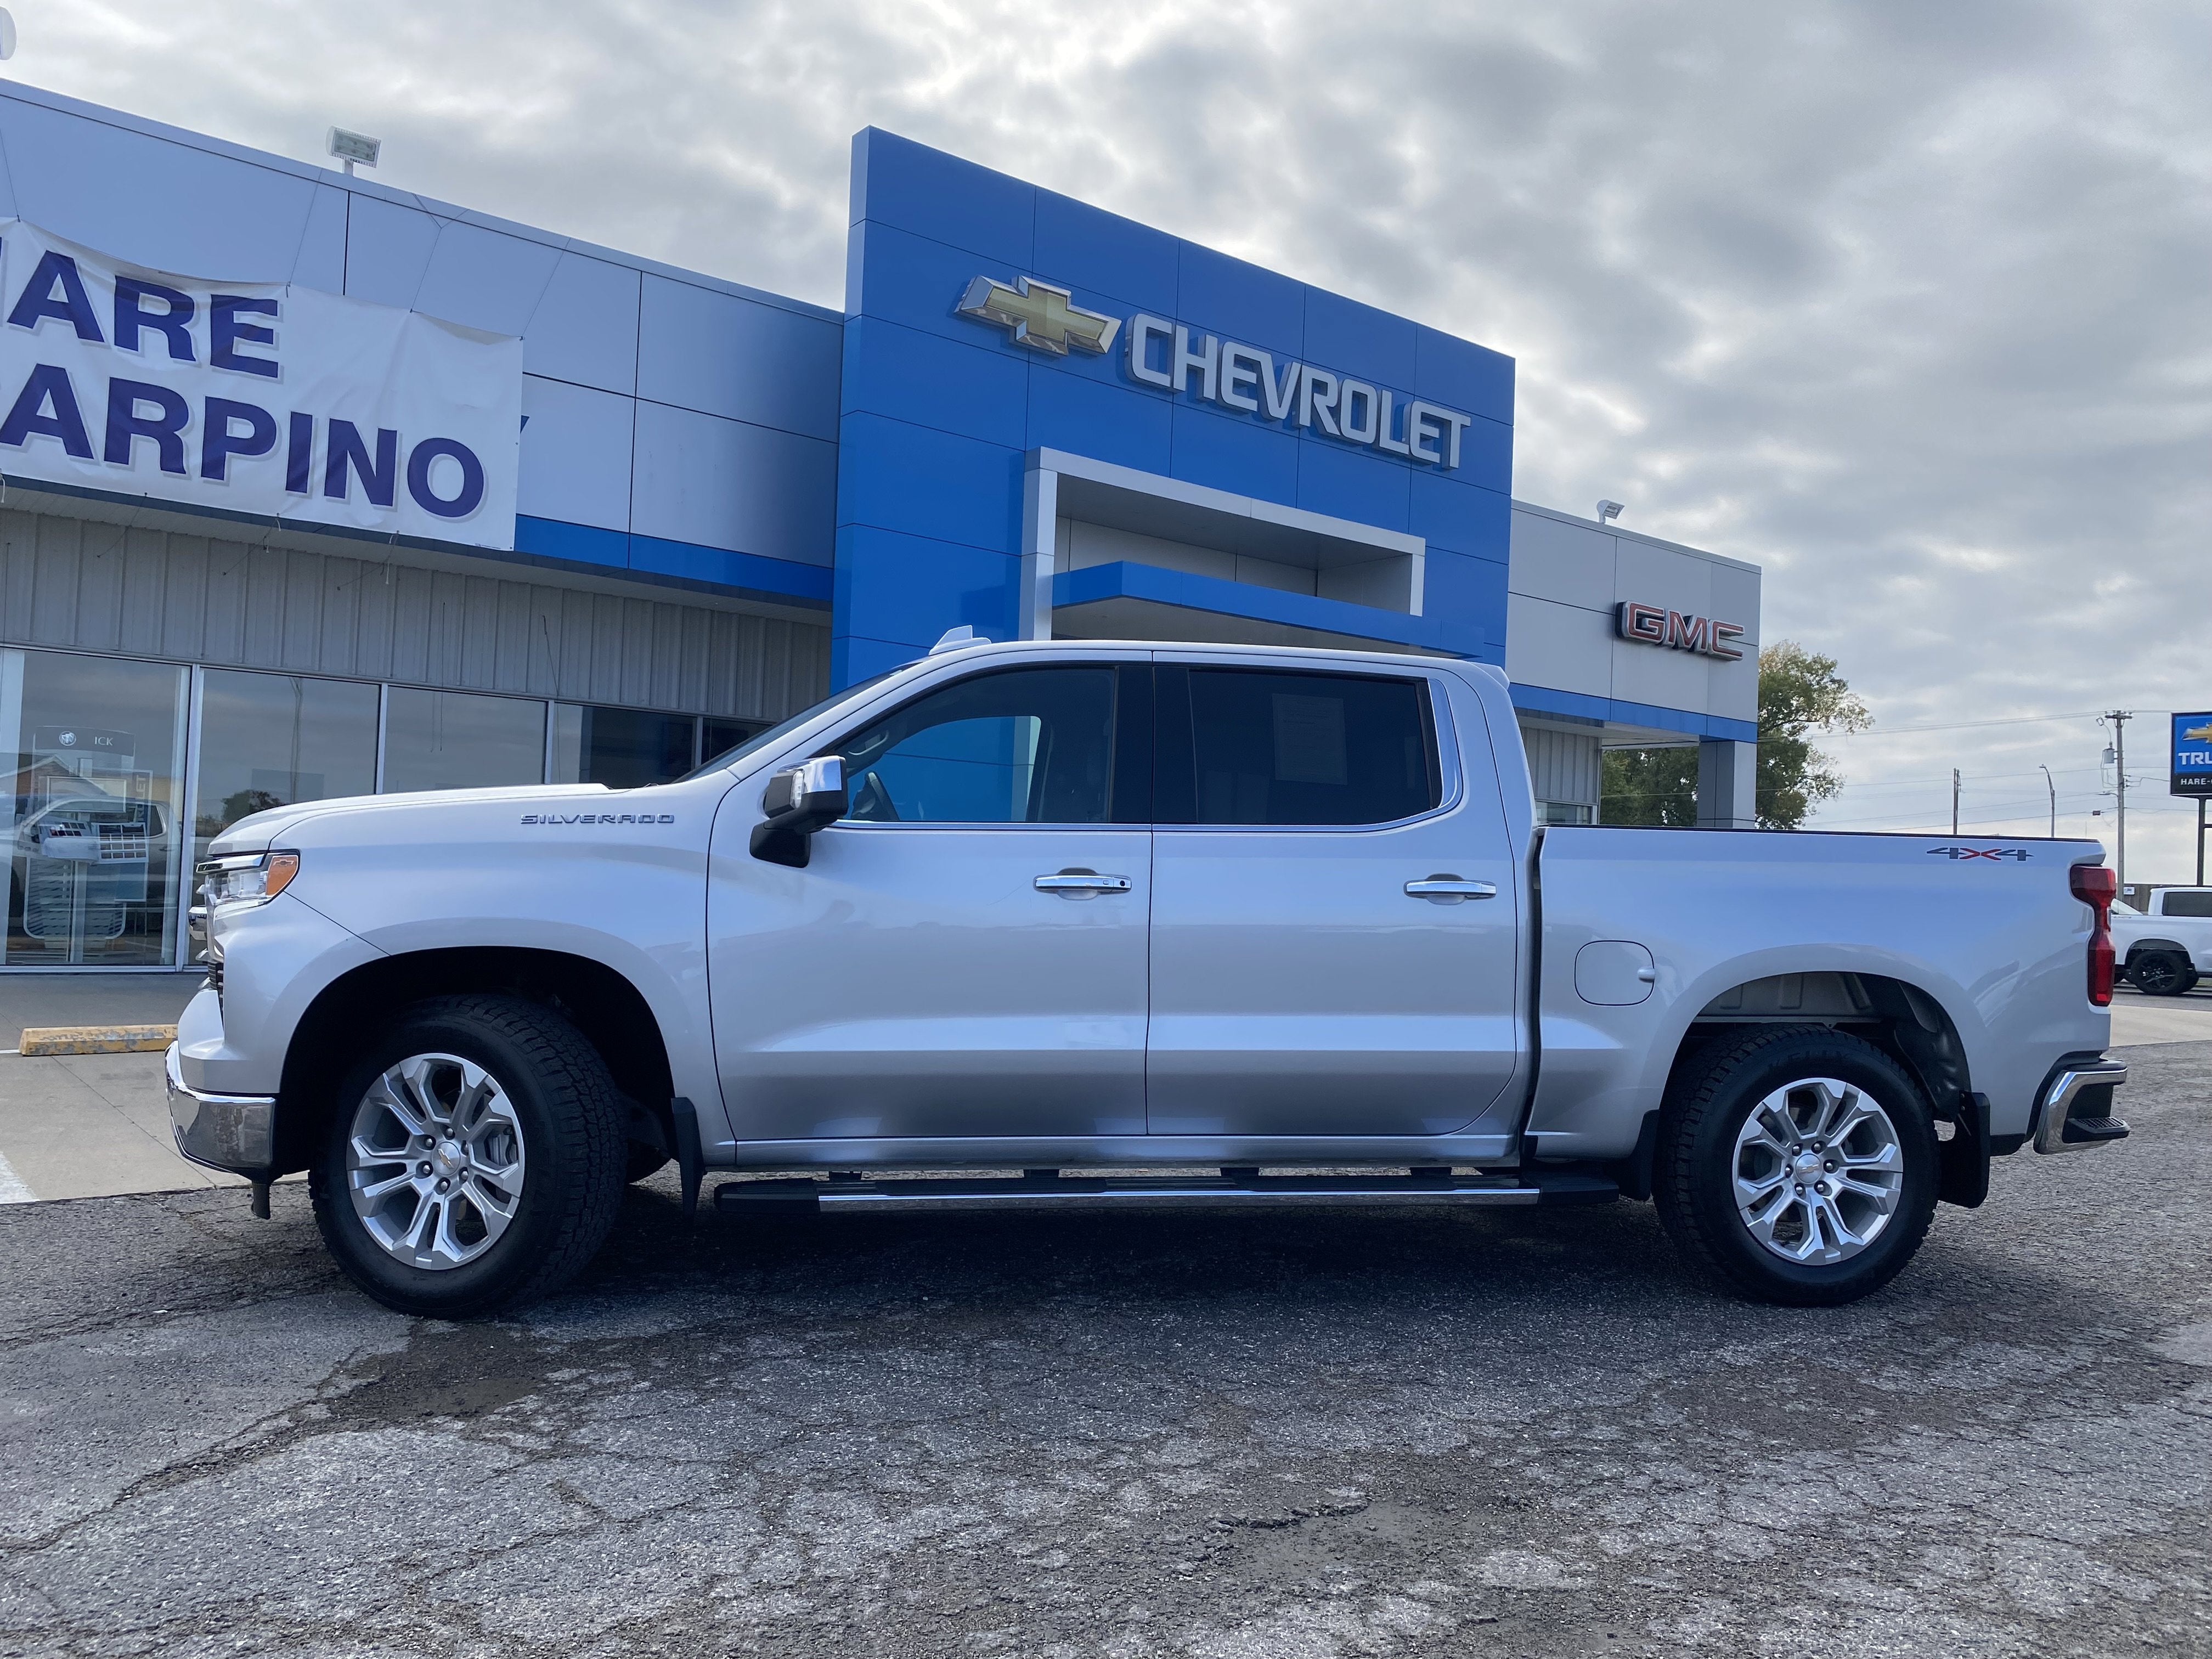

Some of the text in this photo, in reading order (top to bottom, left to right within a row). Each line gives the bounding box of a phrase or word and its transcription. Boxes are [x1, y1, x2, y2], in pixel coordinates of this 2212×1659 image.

[0, 236, 279, 379] ARE
[1125, 313, 1471, 470] CHEVROLET
[1616, 601, 1746, 661] GMC
[521, 814, 675, 824] SILVERADO
